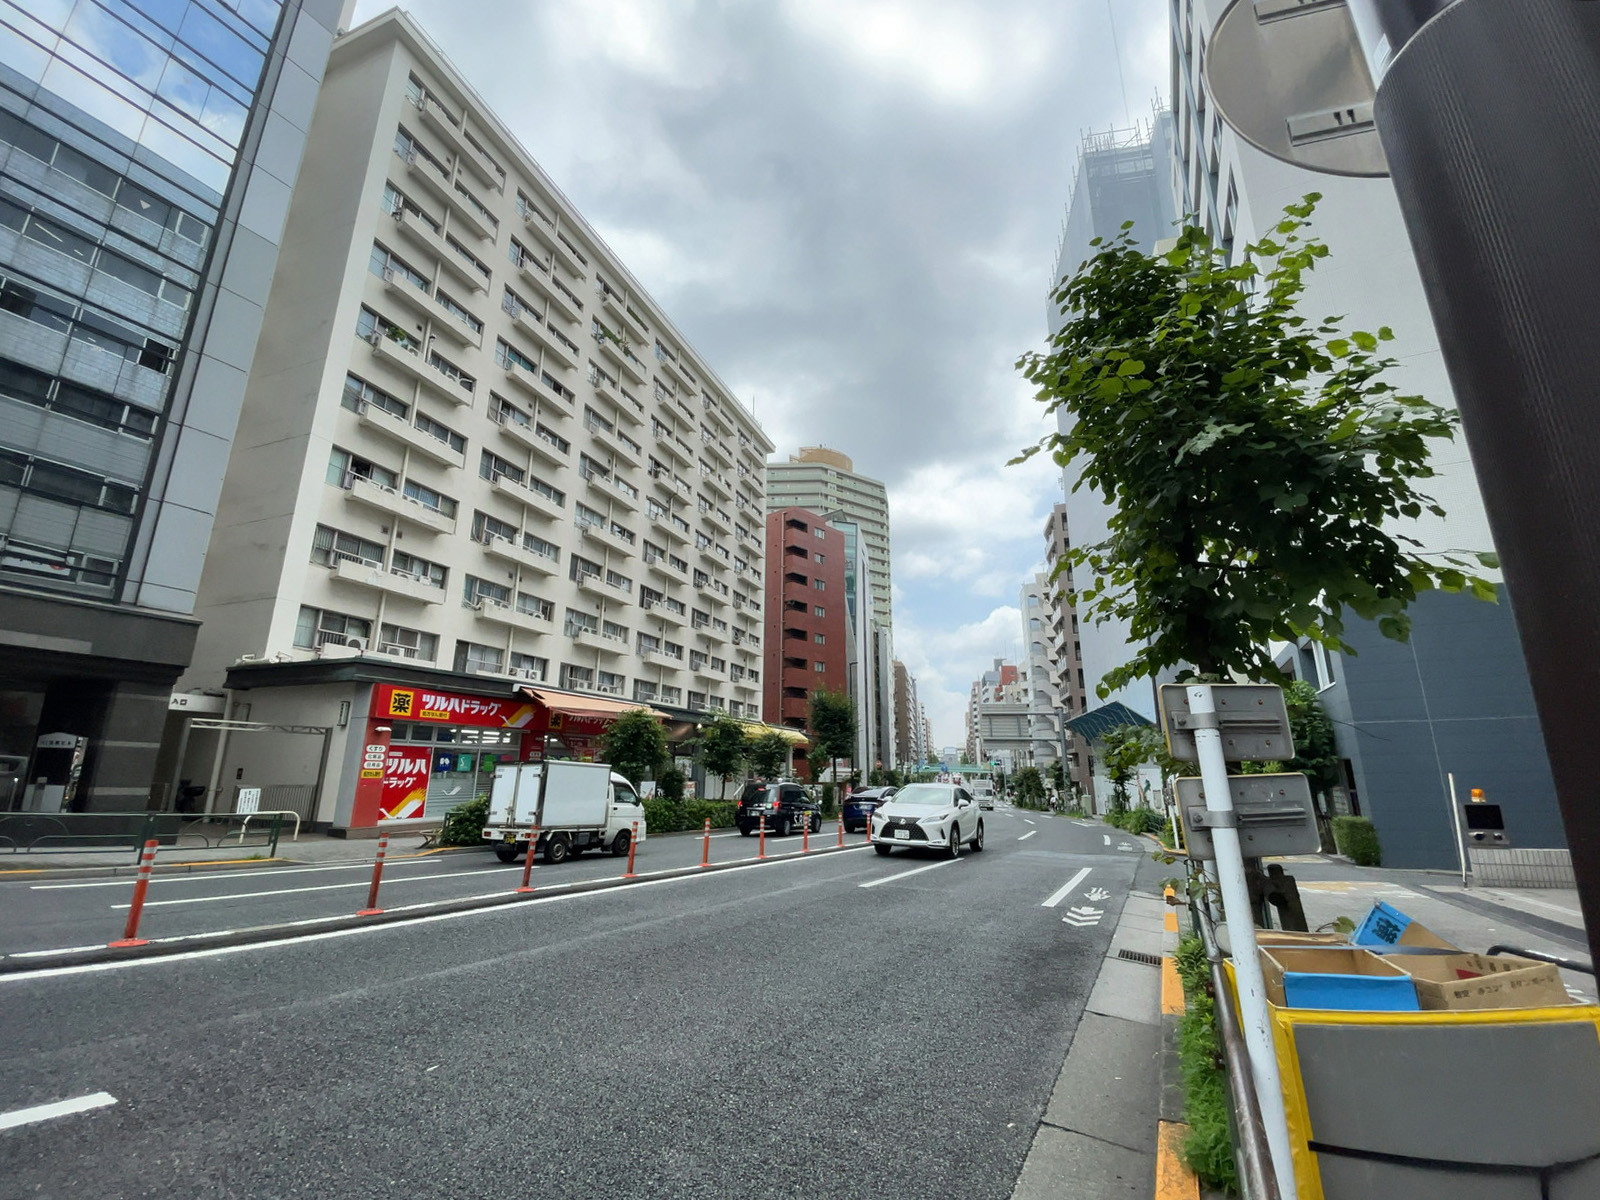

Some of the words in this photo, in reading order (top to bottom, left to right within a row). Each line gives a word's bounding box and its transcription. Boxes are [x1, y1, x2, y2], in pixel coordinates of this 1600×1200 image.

[392, 692, 411, 713] 薬
[422, 694, 502, 716] ツルハドラッグ
[386, 758, 427, 775] ツルハ
